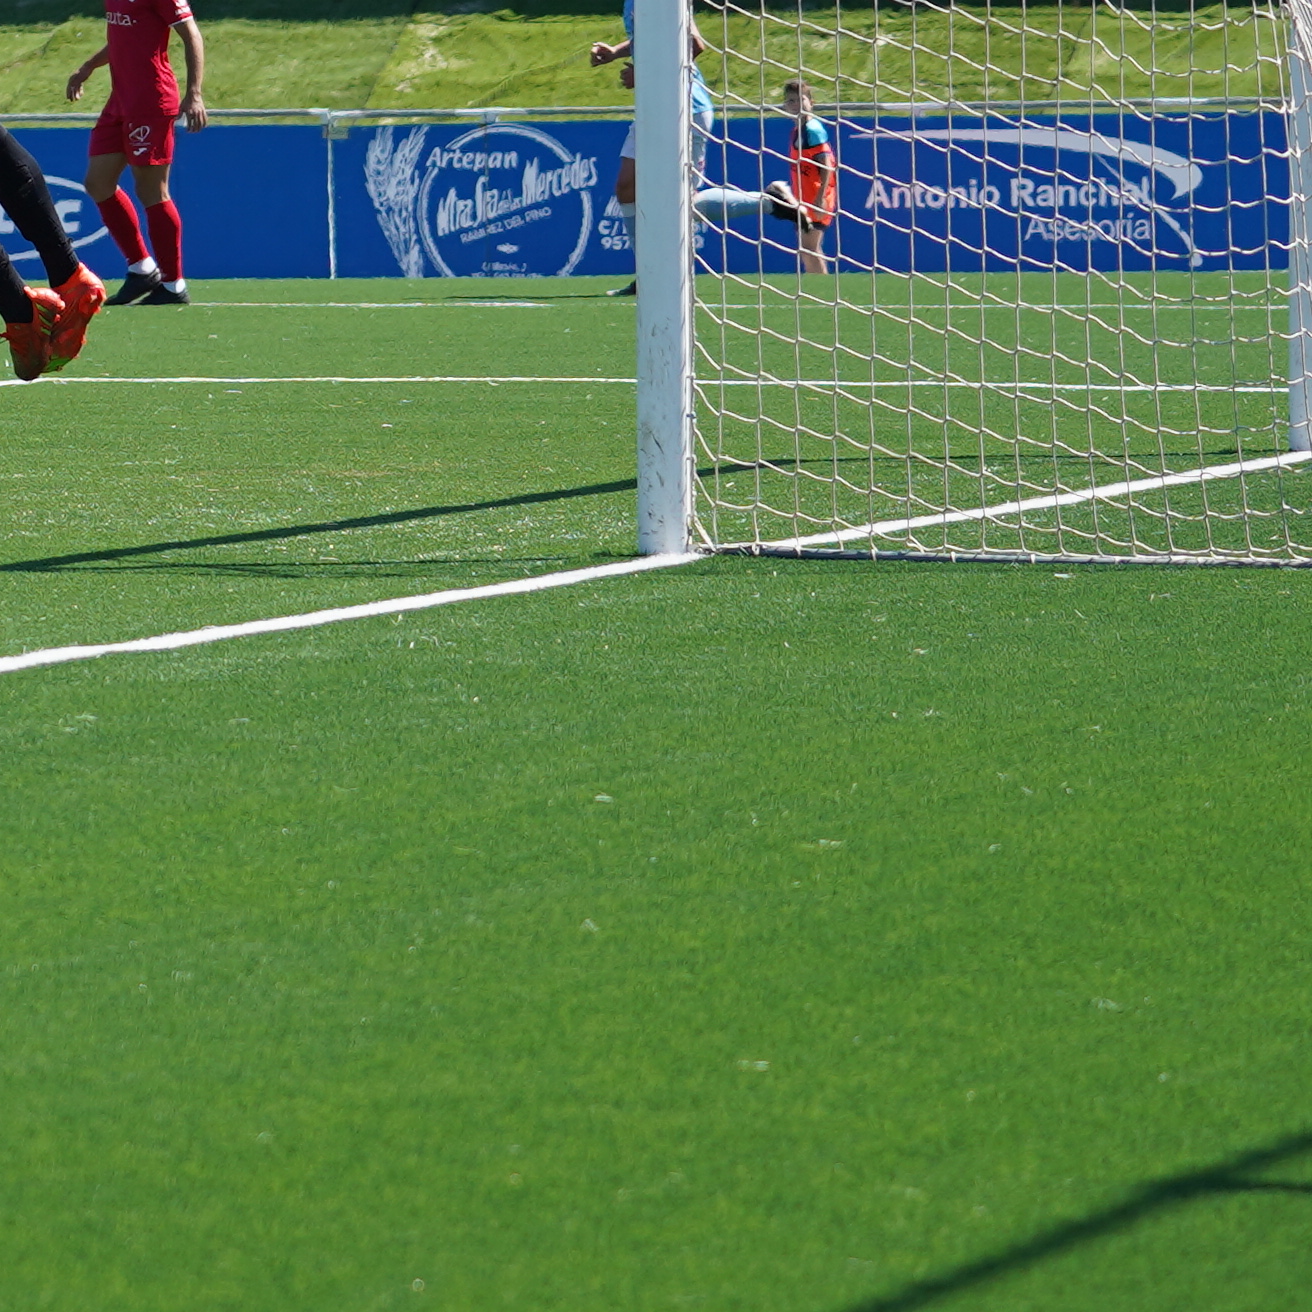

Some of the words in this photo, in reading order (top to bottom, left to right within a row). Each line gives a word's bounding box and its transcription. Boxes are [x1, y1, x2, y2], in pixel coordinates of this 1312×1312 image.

[426, 146, 518, 173] Artepan
[522, 151, 598, 207] Mercedes
[865, 178, 1001, 209] Antonio
[1010, 177, 1151, 208] Ranchal
